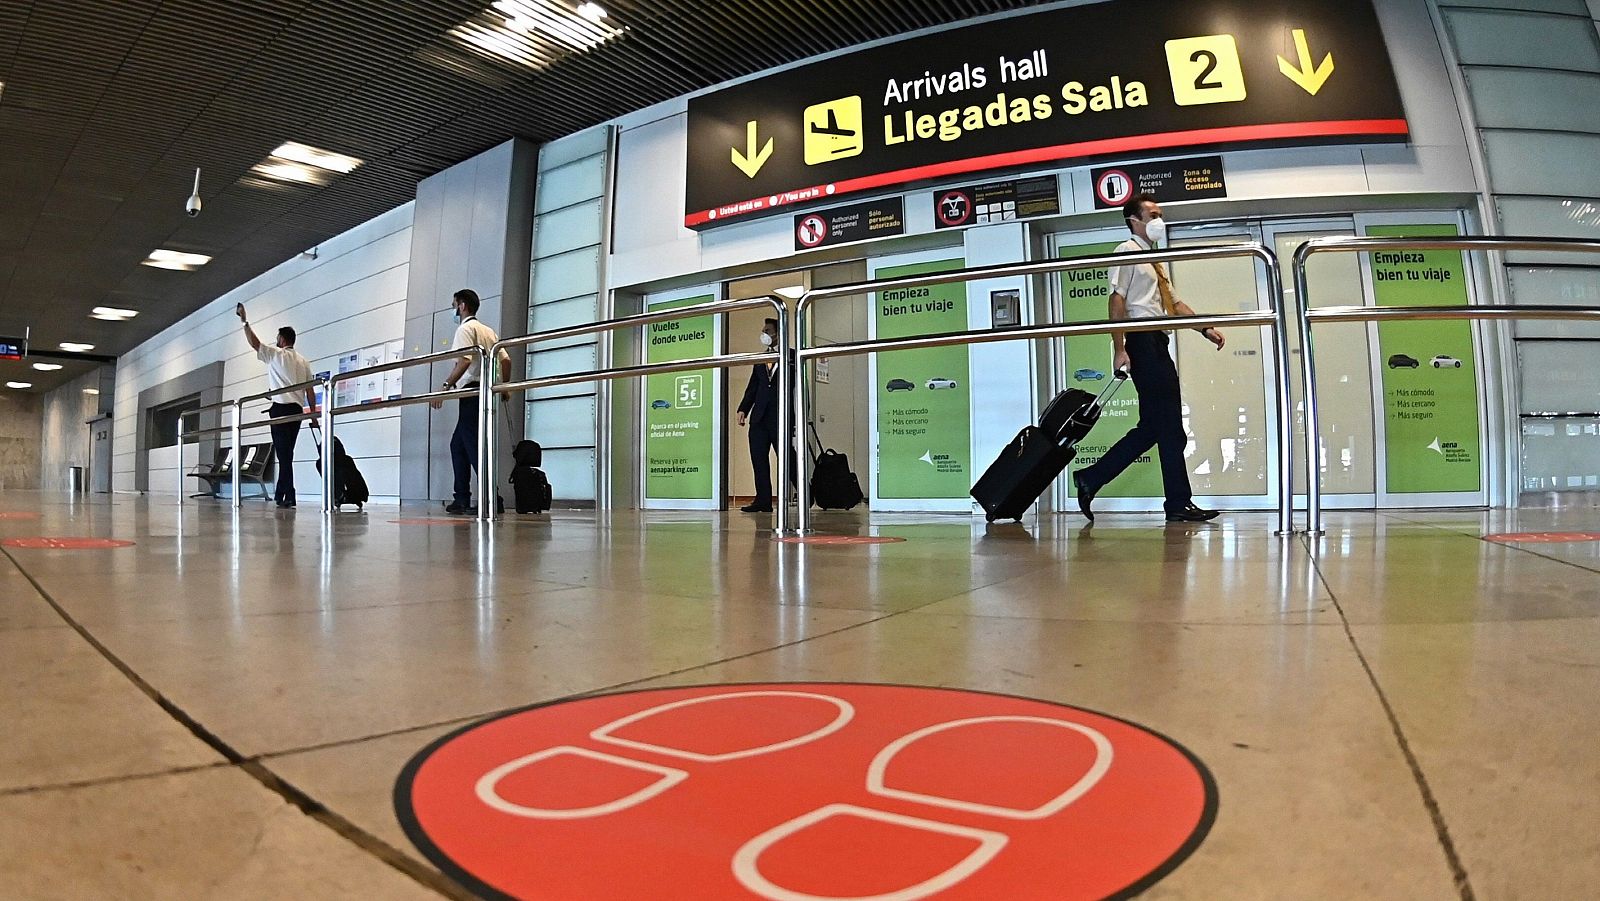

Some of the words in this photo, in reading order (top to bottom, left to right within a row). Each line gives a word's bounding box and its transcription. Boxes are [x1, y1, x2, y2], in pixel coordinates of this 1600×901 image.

[883, 62, 987, 106] Arrivals
[999, 48, 1048, 84] hall
[884, 92, 1052, 146] Llegadas
[1061, 75, 1149, 116] Sala
[1189, 49, 1223, 90] 2
[1139, 172, 1172, 180] Authorized
[1186, 181, 1222, 191] Controlado
[720, 204, 738, 216] Usted
[738, 201, 753, 212] está
[800, 190, 811, 198] are
[812, 187, 819, 196] in
[832, 213, 859, 223] Authorized
[868, 214, 894, 224] personal
[832, 220, 858, 230] personnel
[869, 221, 900, 230] autorizado
[1374, 251, 1424, 265] Empieza
[1376, 269, 1403, 280] bien
[1406, 269, 1419, 280] tu
[1422, 268, 1450, 282] viaje
[882, 288, 929, 301] Empieza
[1069, 285, 1107, 298] donde
[883, 305, 906, 316] bien
[910, 303, 922, 313] tu
[926, 299, 953, 312] viaje
[652, 321, 680, 332] Vueles
[652, 334, 676, 345] donde
[678, 331, 705, 341] vueles
[1412, 412, 1433, 420] seguro
